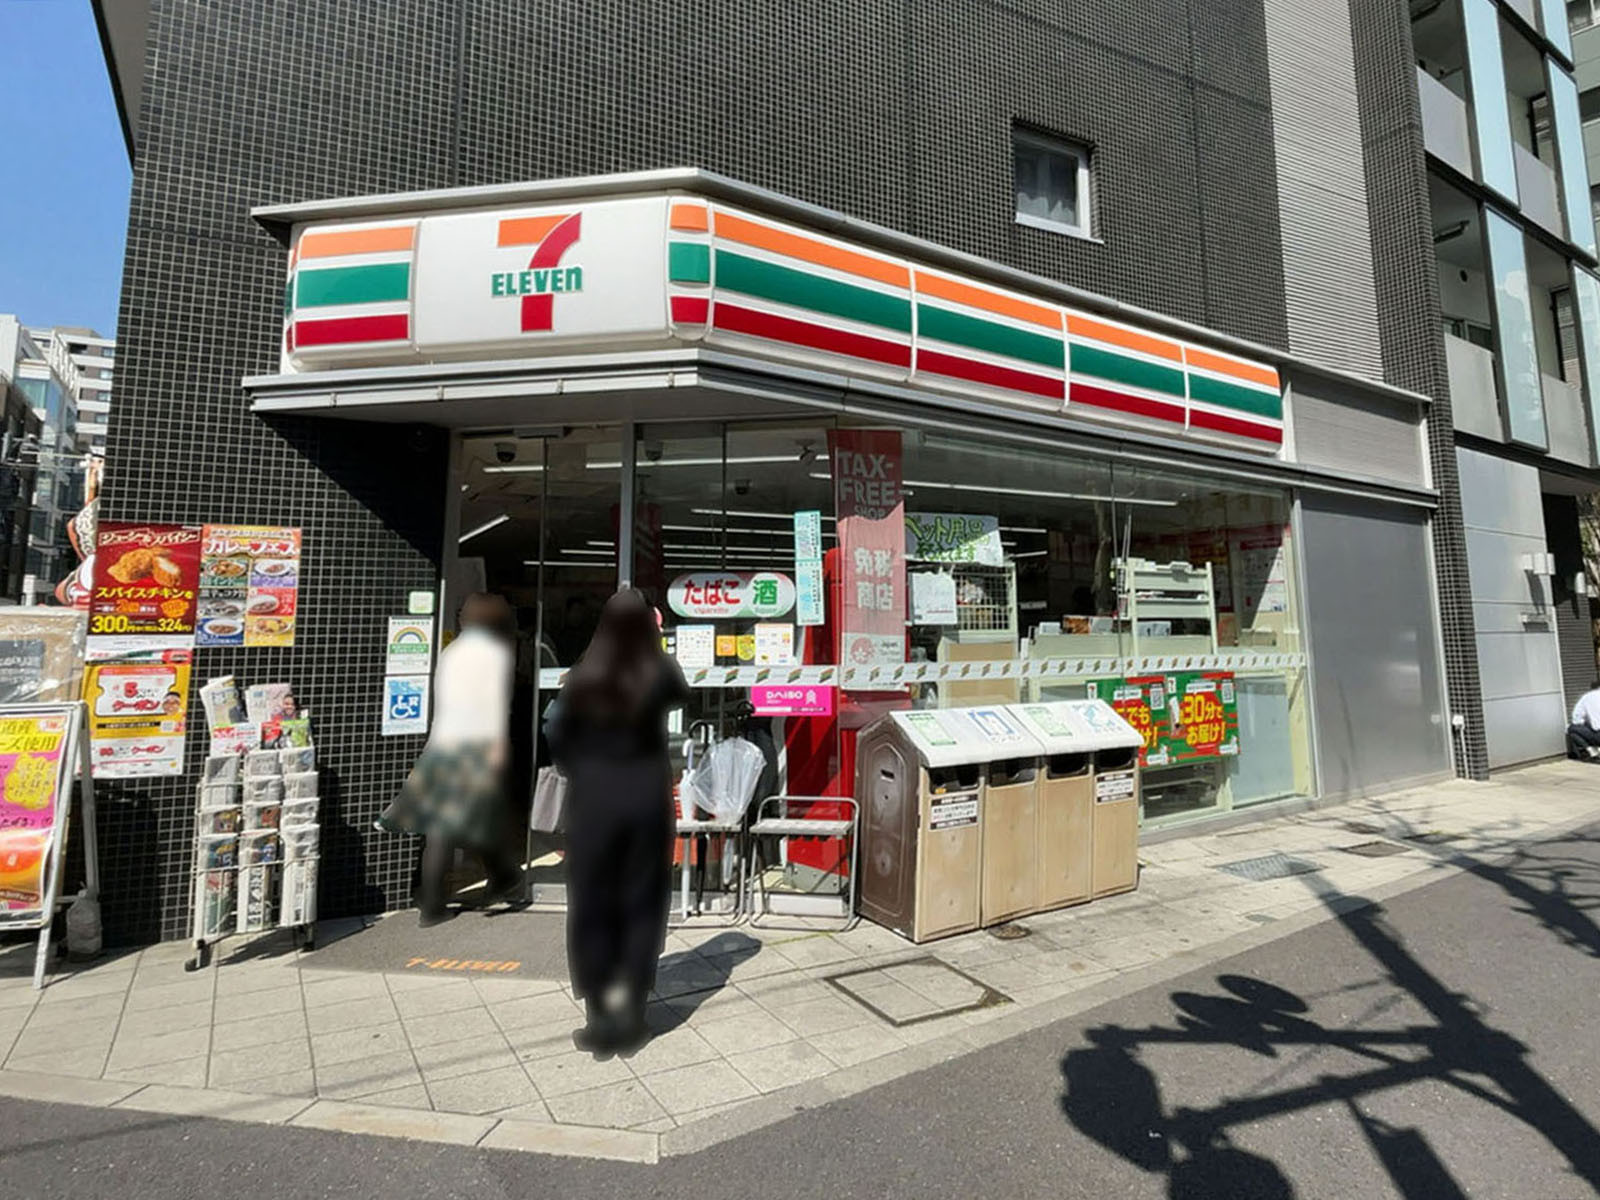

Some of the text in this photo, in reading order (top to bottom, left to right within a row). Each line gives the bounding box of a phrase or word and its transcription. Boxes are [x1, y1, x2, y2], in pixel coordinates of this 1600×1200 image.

[498, 211, 582, 332] 7
[838, 451, 894, 479] TAX-
[840, 478, 897, 505] FREE
[855, 504, 886, 519] SHOP
[205, 539, 296, 555] カレーフェス
[684, 579, 778, 605] たばこ 酒
